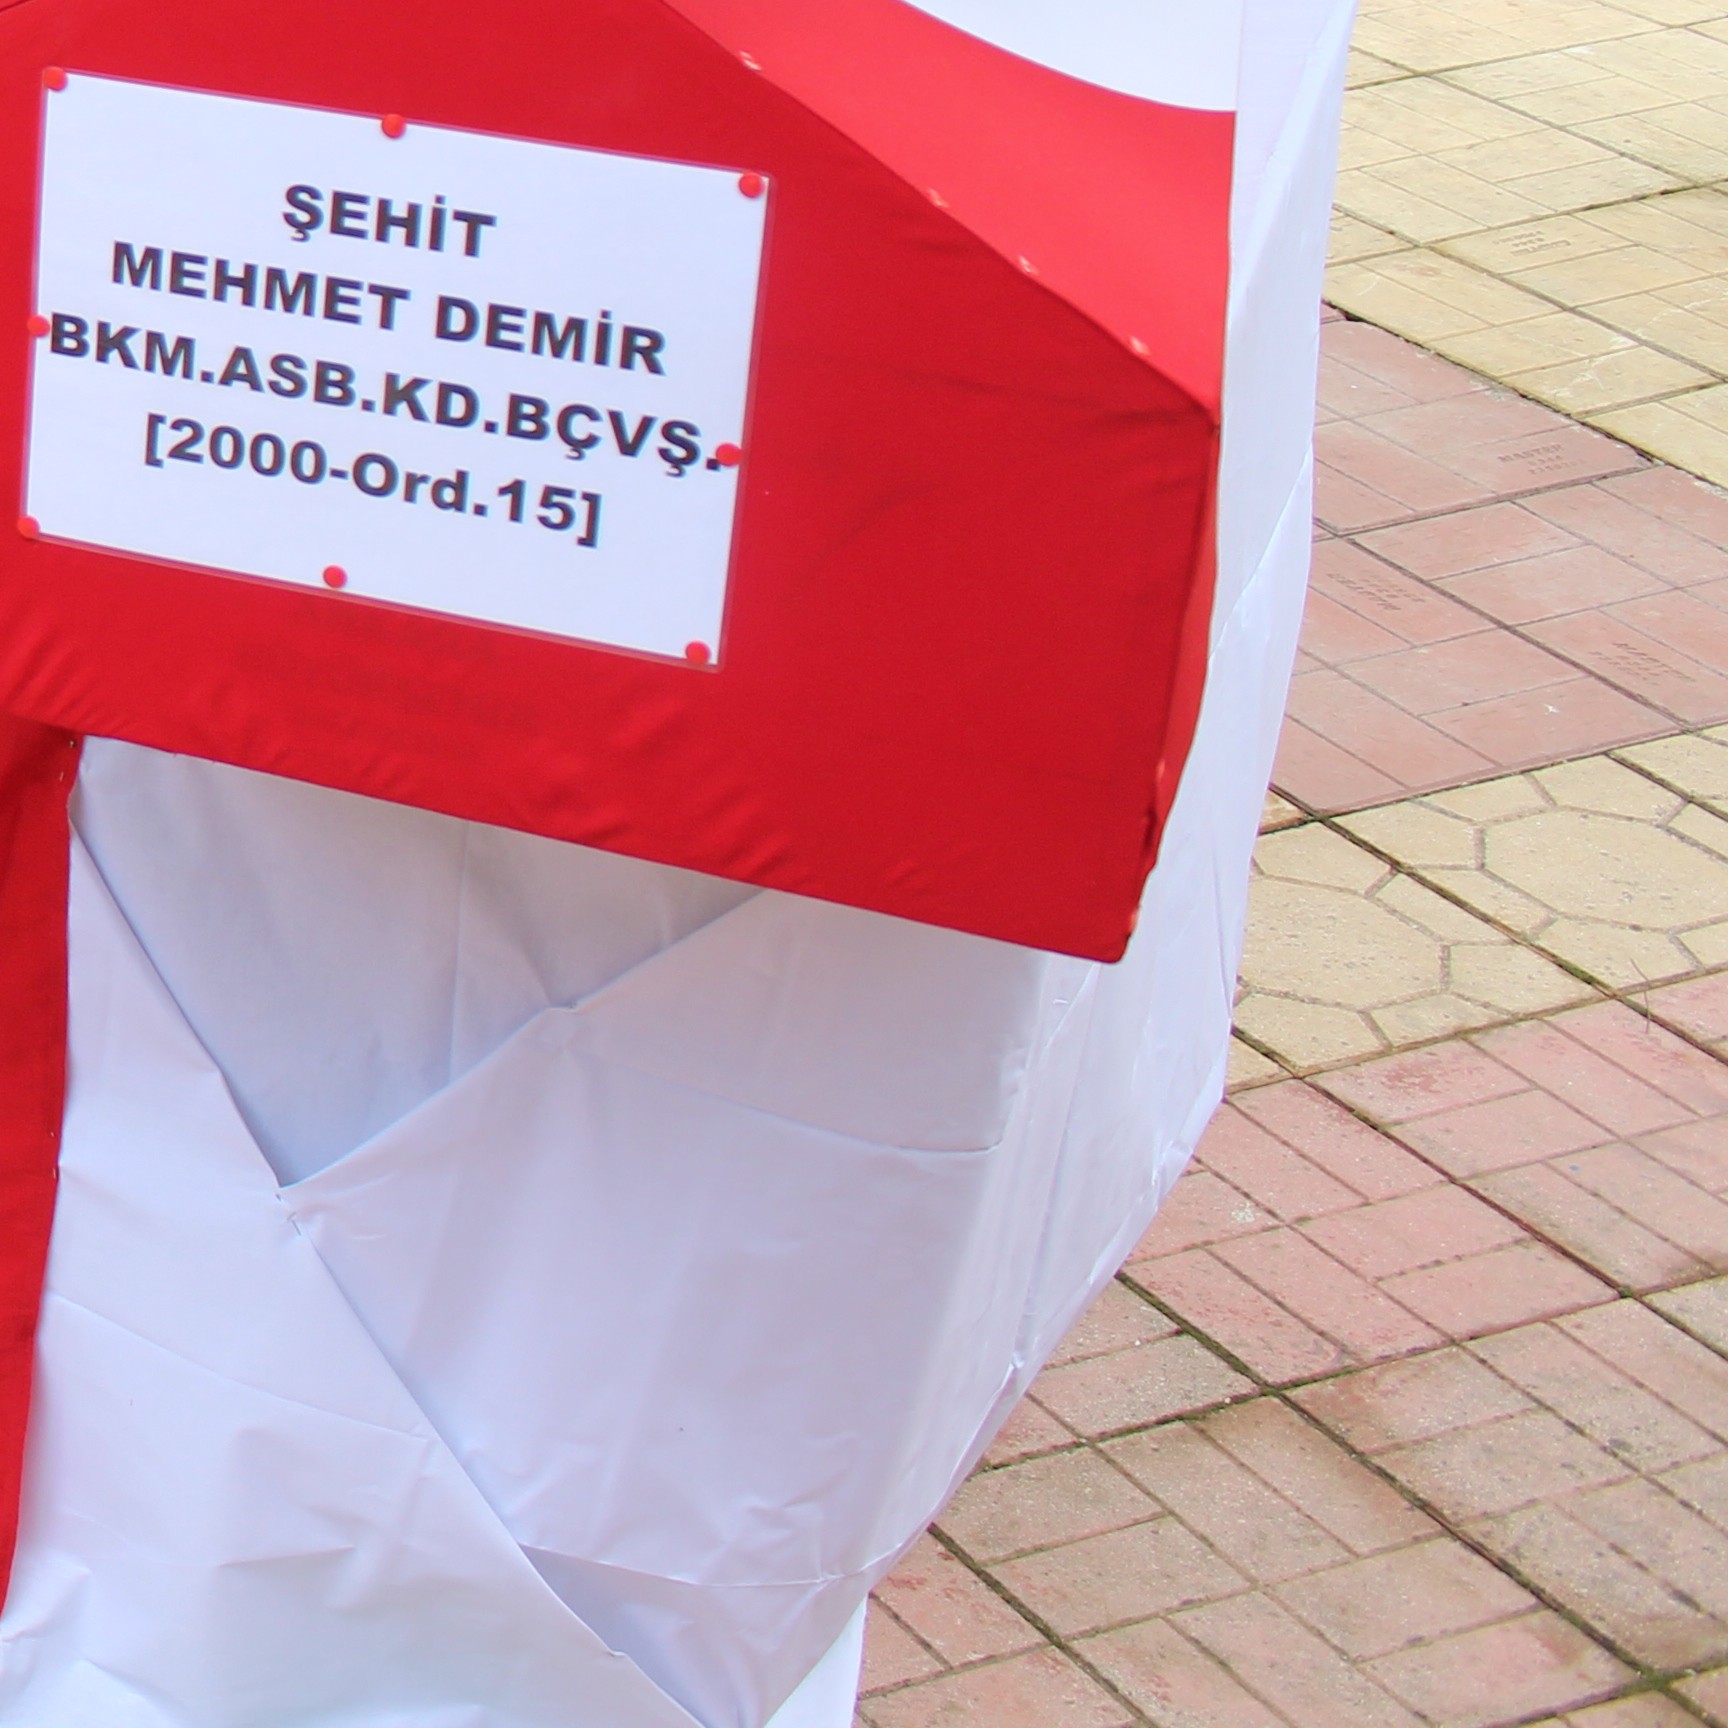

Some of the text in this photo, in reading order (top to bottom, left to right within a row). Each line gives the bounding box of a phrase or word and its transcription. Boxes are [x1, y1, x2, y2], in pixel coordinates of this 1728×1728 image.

[282, 184, 497, 257] ŞEHİT
[111, 241, 667, 376] MEHMET DEMİR
[48, 313, 724, 479] BKM.ASB.KD.BÇVŞ.
[143, 410, 602, 549] [2000-Ord.15]
